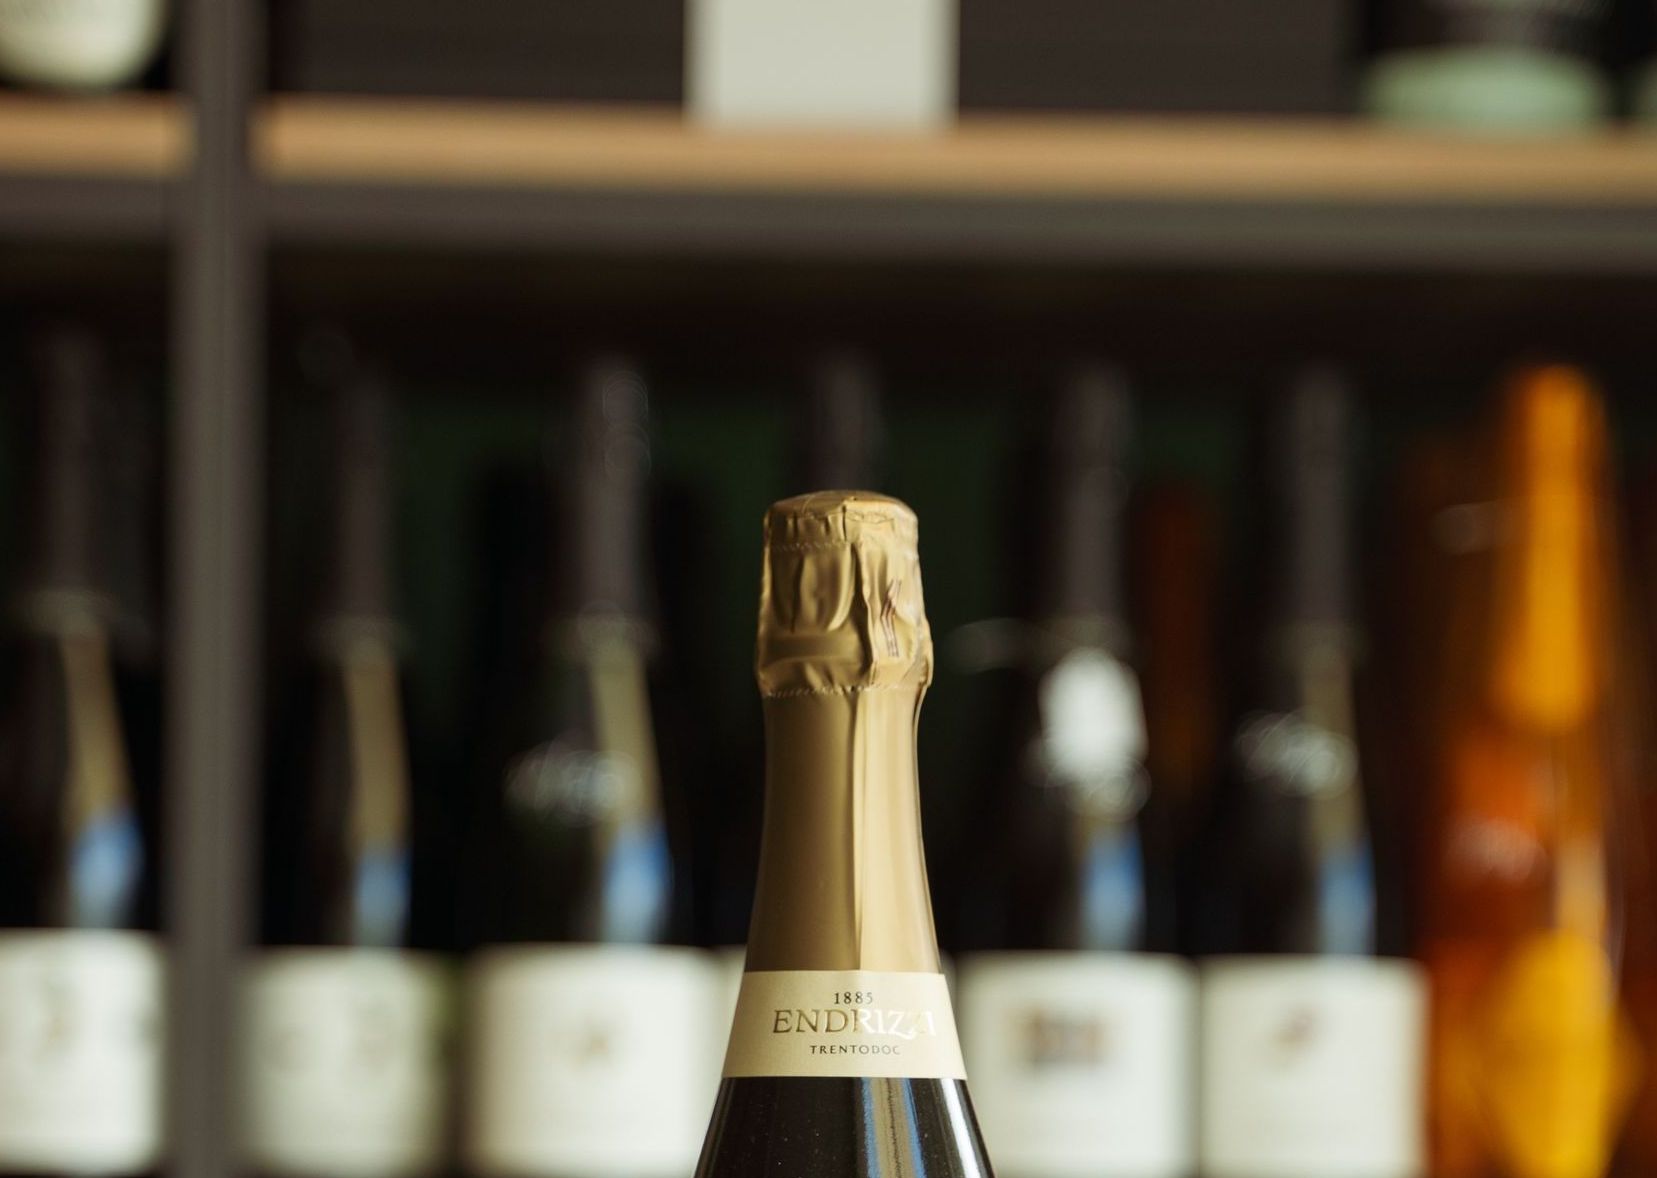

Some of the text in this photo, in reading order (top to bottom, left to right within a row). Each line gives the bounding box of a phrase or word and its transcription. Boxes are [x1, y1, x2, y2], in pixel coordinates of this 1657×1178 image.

[833, 992, 873, 1005] 1885
[773, 1009, 937, 1040] ENDRIZI
[810, 1045, 901, 1055] TRENTODOC
